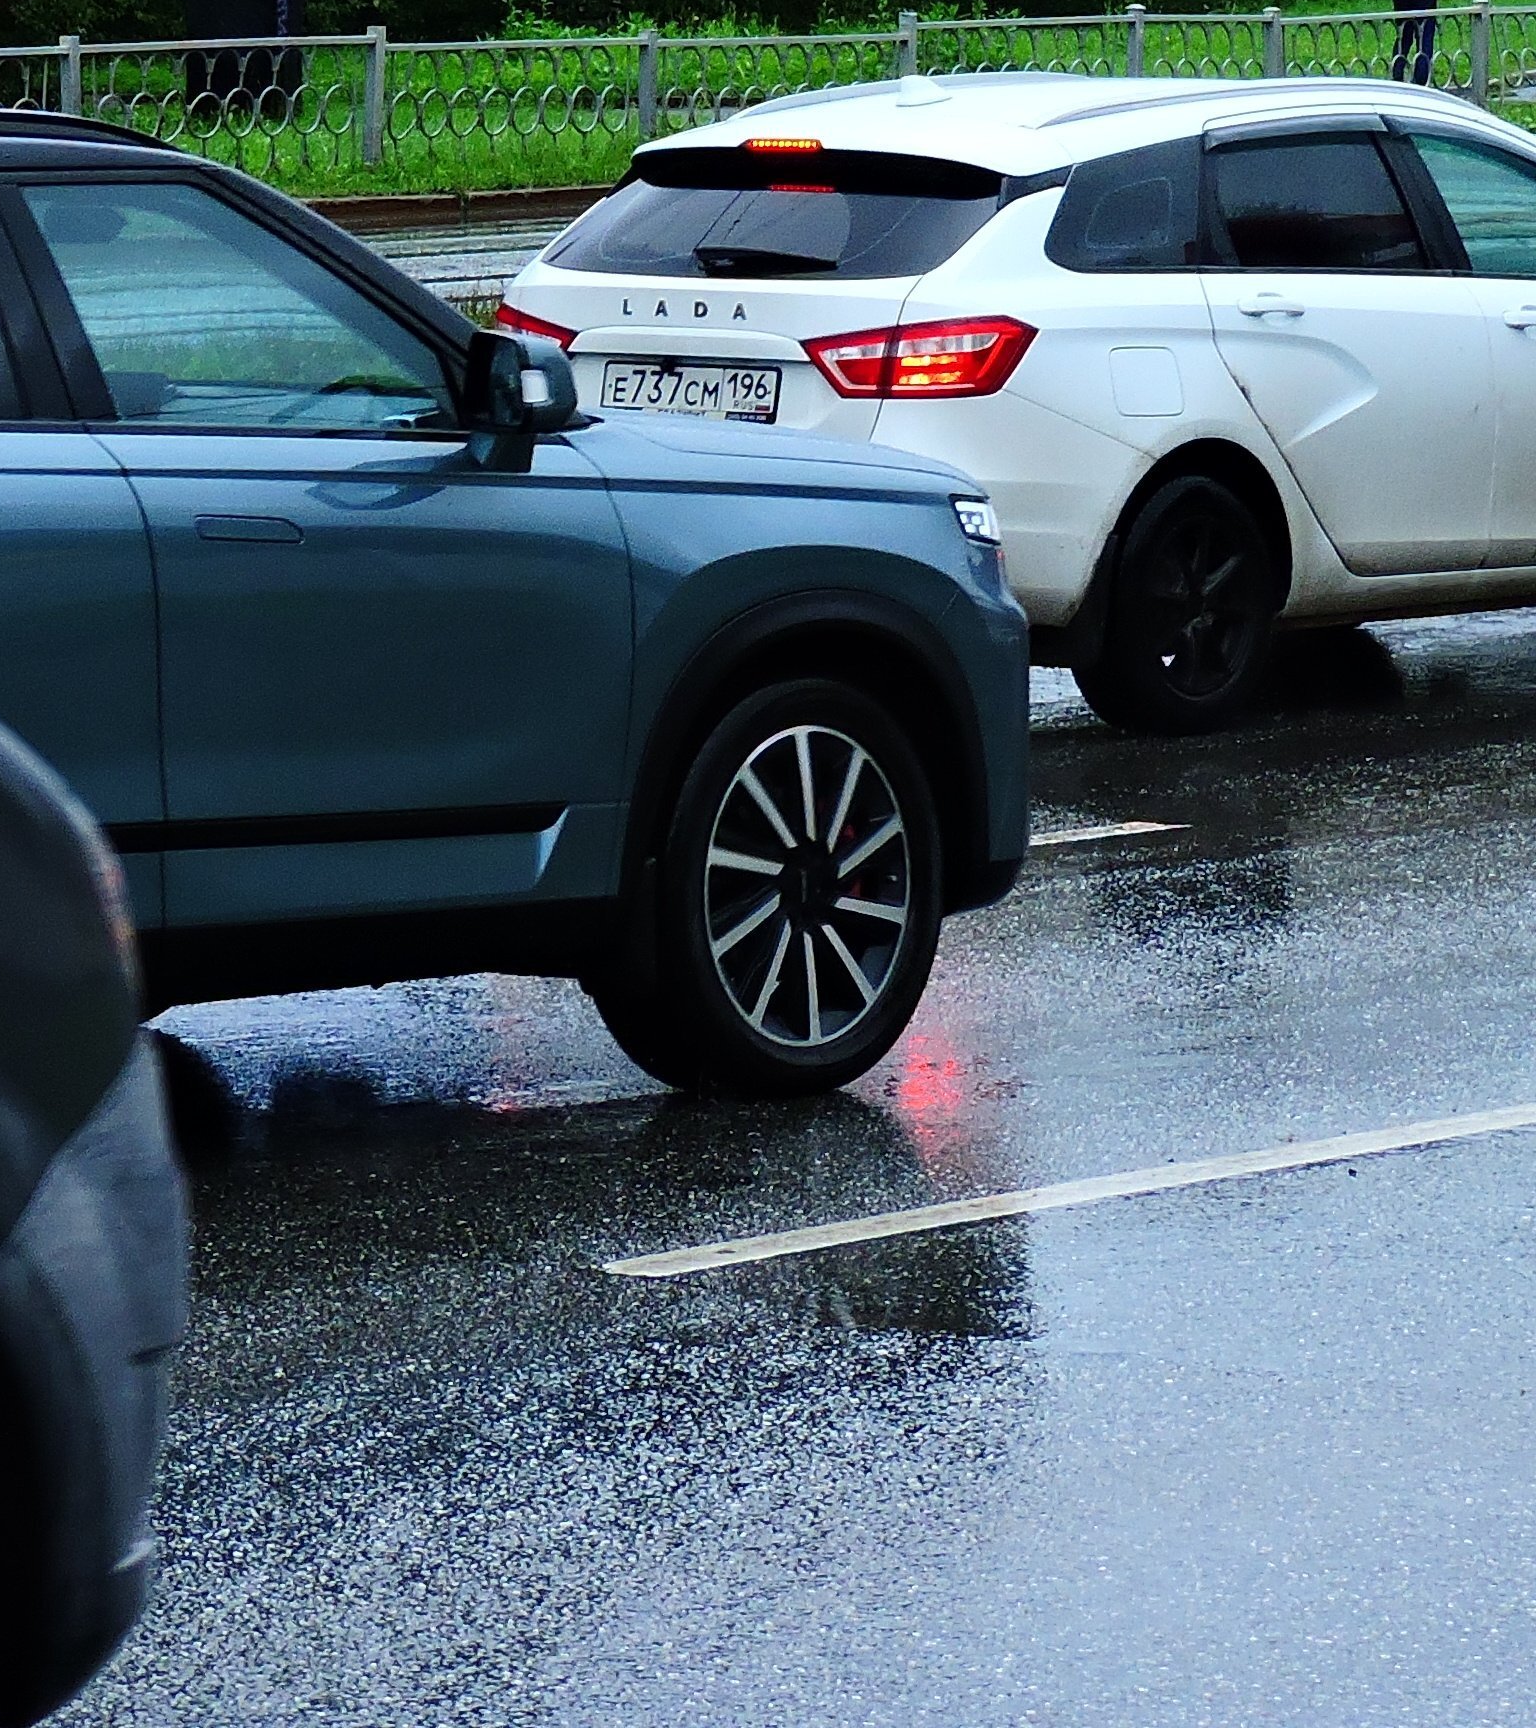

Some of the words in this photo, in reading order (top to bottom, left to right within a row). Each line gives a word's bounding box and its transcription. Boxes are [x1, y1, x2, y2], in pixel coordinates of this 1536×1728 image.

[622, 298, 747, 321] LADA
[612, 369, 720, 408] Е737СМ
[726, 372, 769, 400] 196
